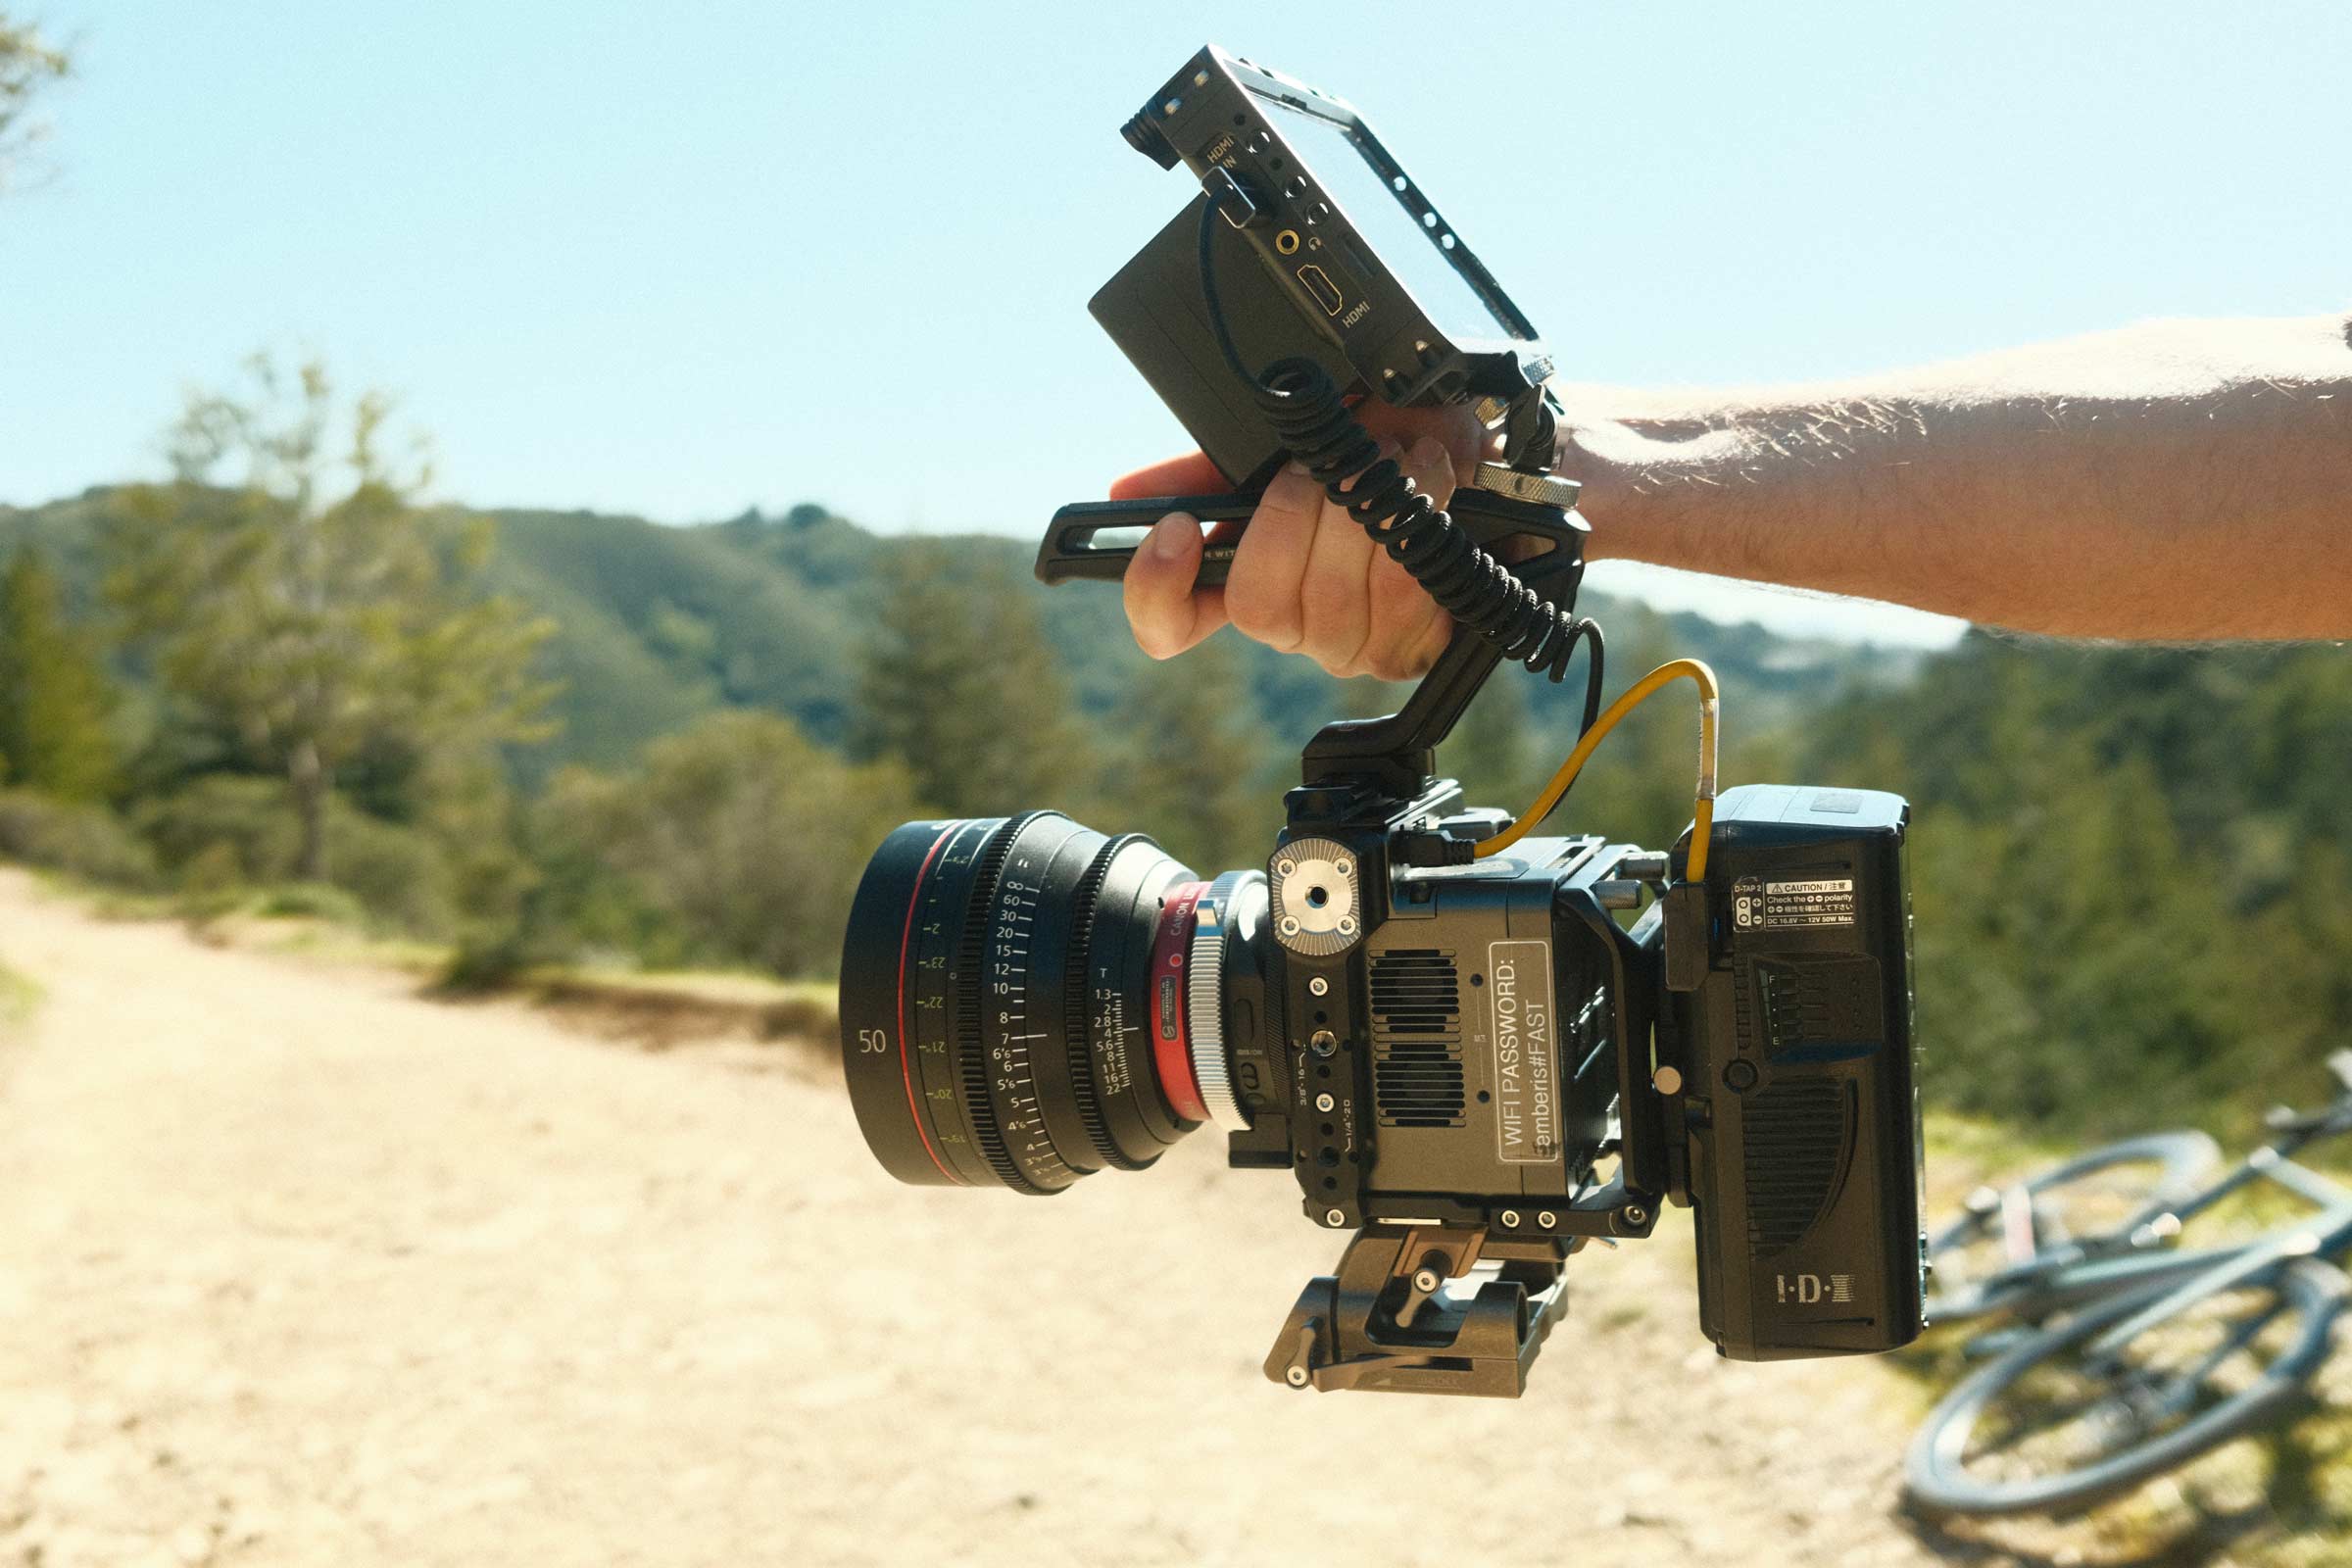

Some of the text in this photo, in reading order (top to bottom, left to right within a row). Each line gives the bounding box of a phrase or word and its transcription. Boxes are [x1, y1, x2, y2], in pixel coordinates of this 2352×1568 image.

[1206, 136, 1235, 164] HDMI
[1222, 156, 1237, 169] IN
[1343, 301, 1370, 328] HDMI
[1784, 883, 1823, 893] CAUTION
[1003, 895, 1020, 906] 60
[1824, 894, 1853, 903] polarity
[1000, 909, 1016, 921] 30
[1170, 902, 1190, 937] CANON
[932, 923, 941, 934] 2
[997, 926, 1013, 938] 20
[996, 944, 1011, 956] 15
[995, 962, 1009, 975] 12
[1100, 967, 1108, 978] T
[1769, 975, 1776, 984] F
[993, 982, 1008, 995] 10
[1096, 989, 1112, 1000] 1.3
[1104, 1004, 1111, 1014] 2
[1000, 1011, 1009, 1024] 8
[1094, 1015, 1112, 1028] 2.8
[1001, 1032, 1009, 1045] 7
[1104, 1028, 1112, 1038] 4
[858, 1029, 887, 1054] 50
[1097, 1040, 1114, 1052] 5.6
[1772, 1036, 1780, 1046] E
[1106, 1051, 1115, 1061] 8
[1496, 958, 1523, 1147] WIFI PASSWORD:
[1004, 1060, 1013, 1072] 6
[1102, 1062, 1116, 1074] 11
[1104, 1073, 1118, 1084] 16
[1525, 999, 1551, 1148] emberis#FAST
[1106, 1084, 1121, 1095] 22
[1010, 1097, 1020, 1108] 5
